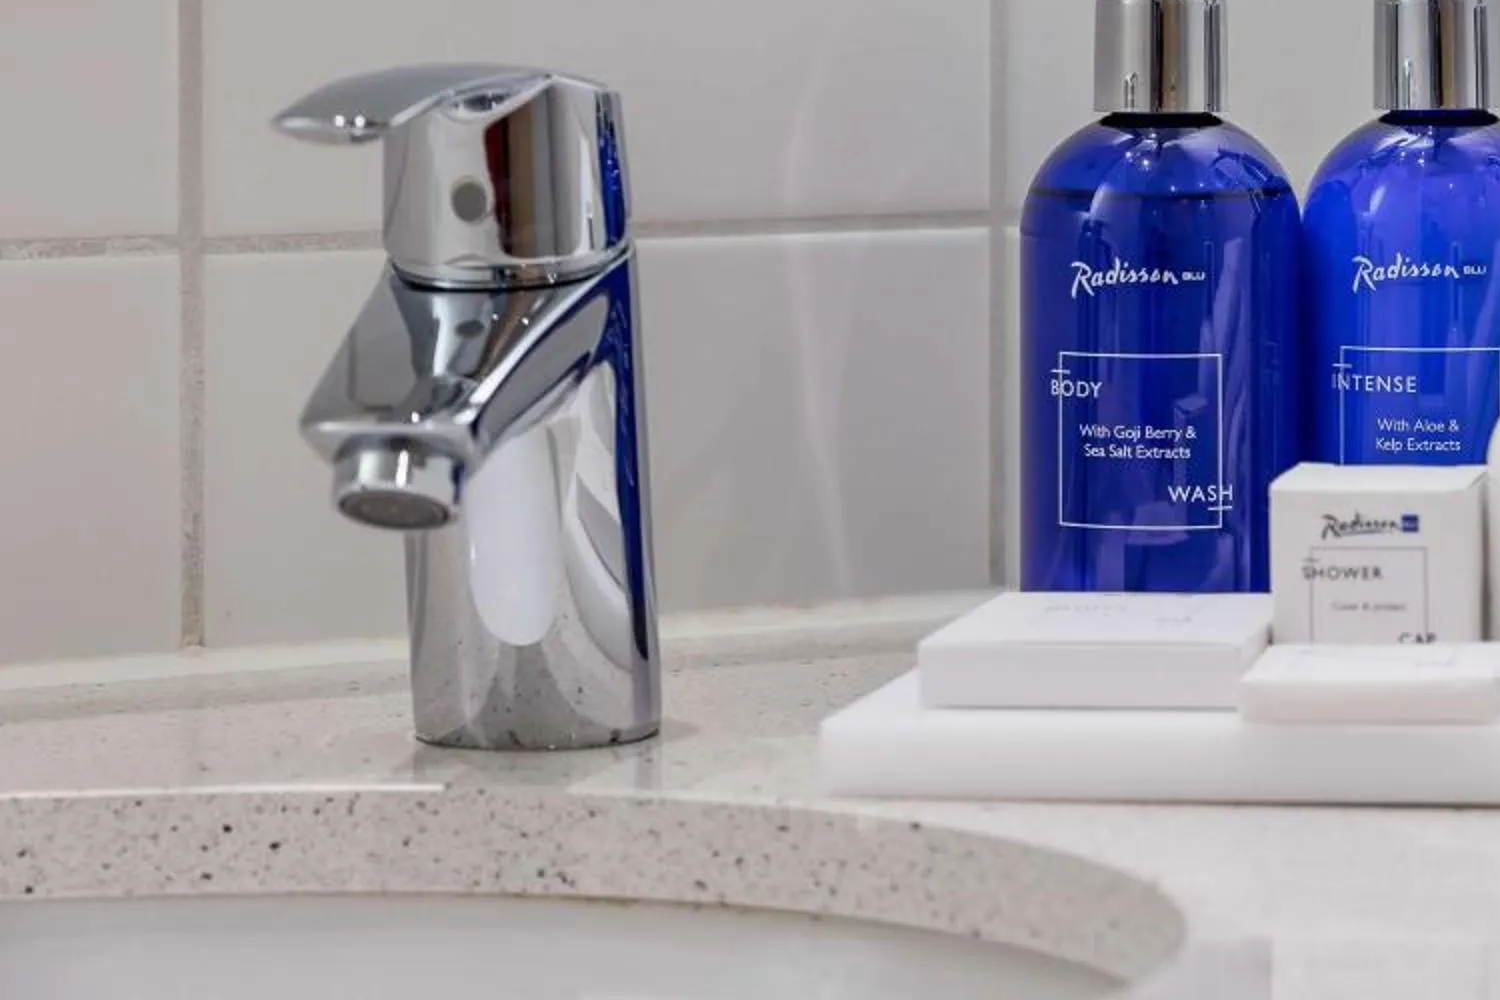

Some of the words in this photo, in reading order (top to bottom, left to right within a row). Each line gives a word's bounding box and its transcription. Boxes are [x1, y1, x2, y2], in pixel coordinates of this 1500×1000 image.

[1071, 257, 1178, 299] Radisson
[1352, 253, 1459, 294] Radisson
[1050, 379, 1103, 398] BODY
[1332, 373, 1417, 393] INTENSE
[1079, 425, 1111, 439] With
[1113, 425, 1141, 442] Goji
[1145, 426, 1182, 442] Berry
[1185, 427, 1197, 439] &
[1377, 418, 1409, 432] With
[1413, 418, 1445, 433] Aloe
[1448, 420, 1460, 433] &
[1083, 445, 1106, 458] Sea
[1109, 445, 1133, 459] Salt
[1136, 446, 1191, 460] Extracts
[1375, 437, 1403, 454] Kelp
[1407, 438, 1461, 452] Extracts
[1168, 485, 1233, 502] WASH
[1302, 566, 1384, 580] SHOWER
